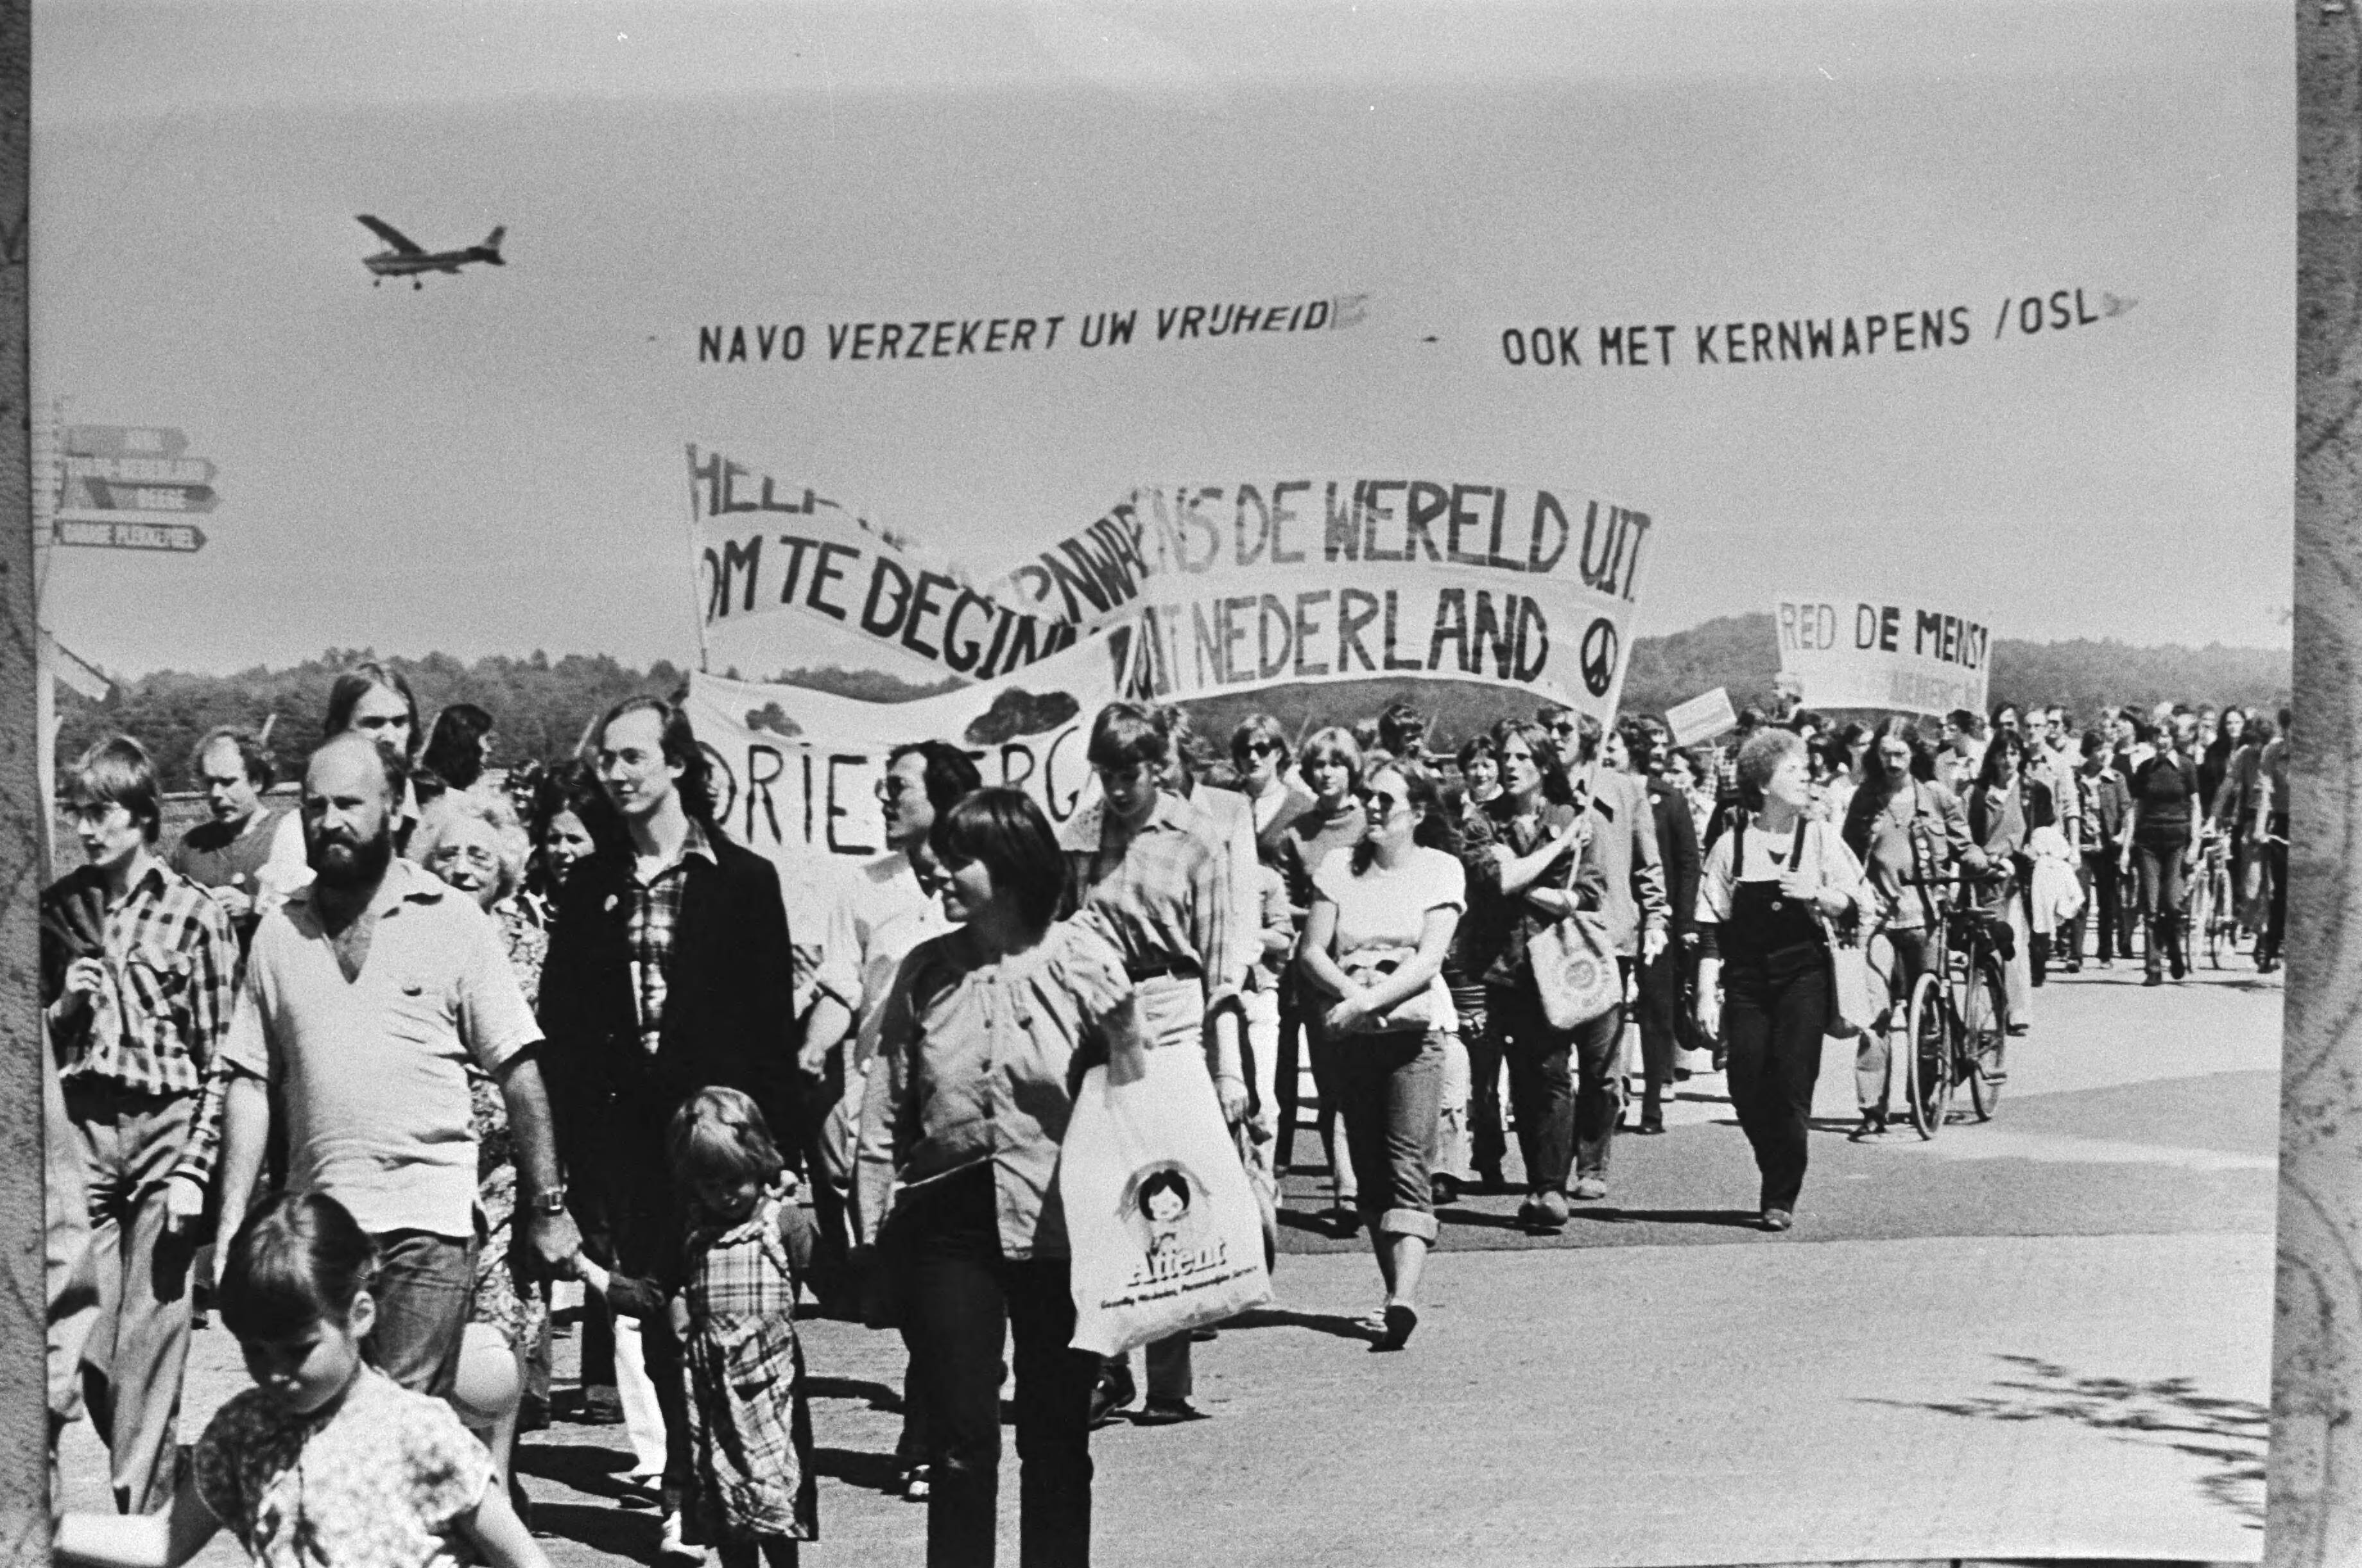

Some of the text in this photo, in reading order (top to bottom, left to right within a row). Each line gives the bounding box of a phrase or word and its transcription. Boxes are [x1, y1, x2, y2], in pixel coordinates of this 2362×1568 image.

[699, 324, 805, 363] NAVO
[829, 316, 1065, 359] VERZEKERT
[1080, 309, 1137, 347] UW
[1502, 327, 1581, 366] OOK
[1599, 325, 1677, 366] MET
[1696, 306, 1970, 365] KERNWAPENS
[1236, 480, 1311, 566] DE
[1324, 479, 1569, 573] WERELD
[1580, 500, 1651, 602] UIT
[779, 534, 861, 622] TE
[1191, 587, 1549, 685] NEDERLAND
[1780, 601, 1836, 650] RED
[1854, 603, 1901, 652] DE
